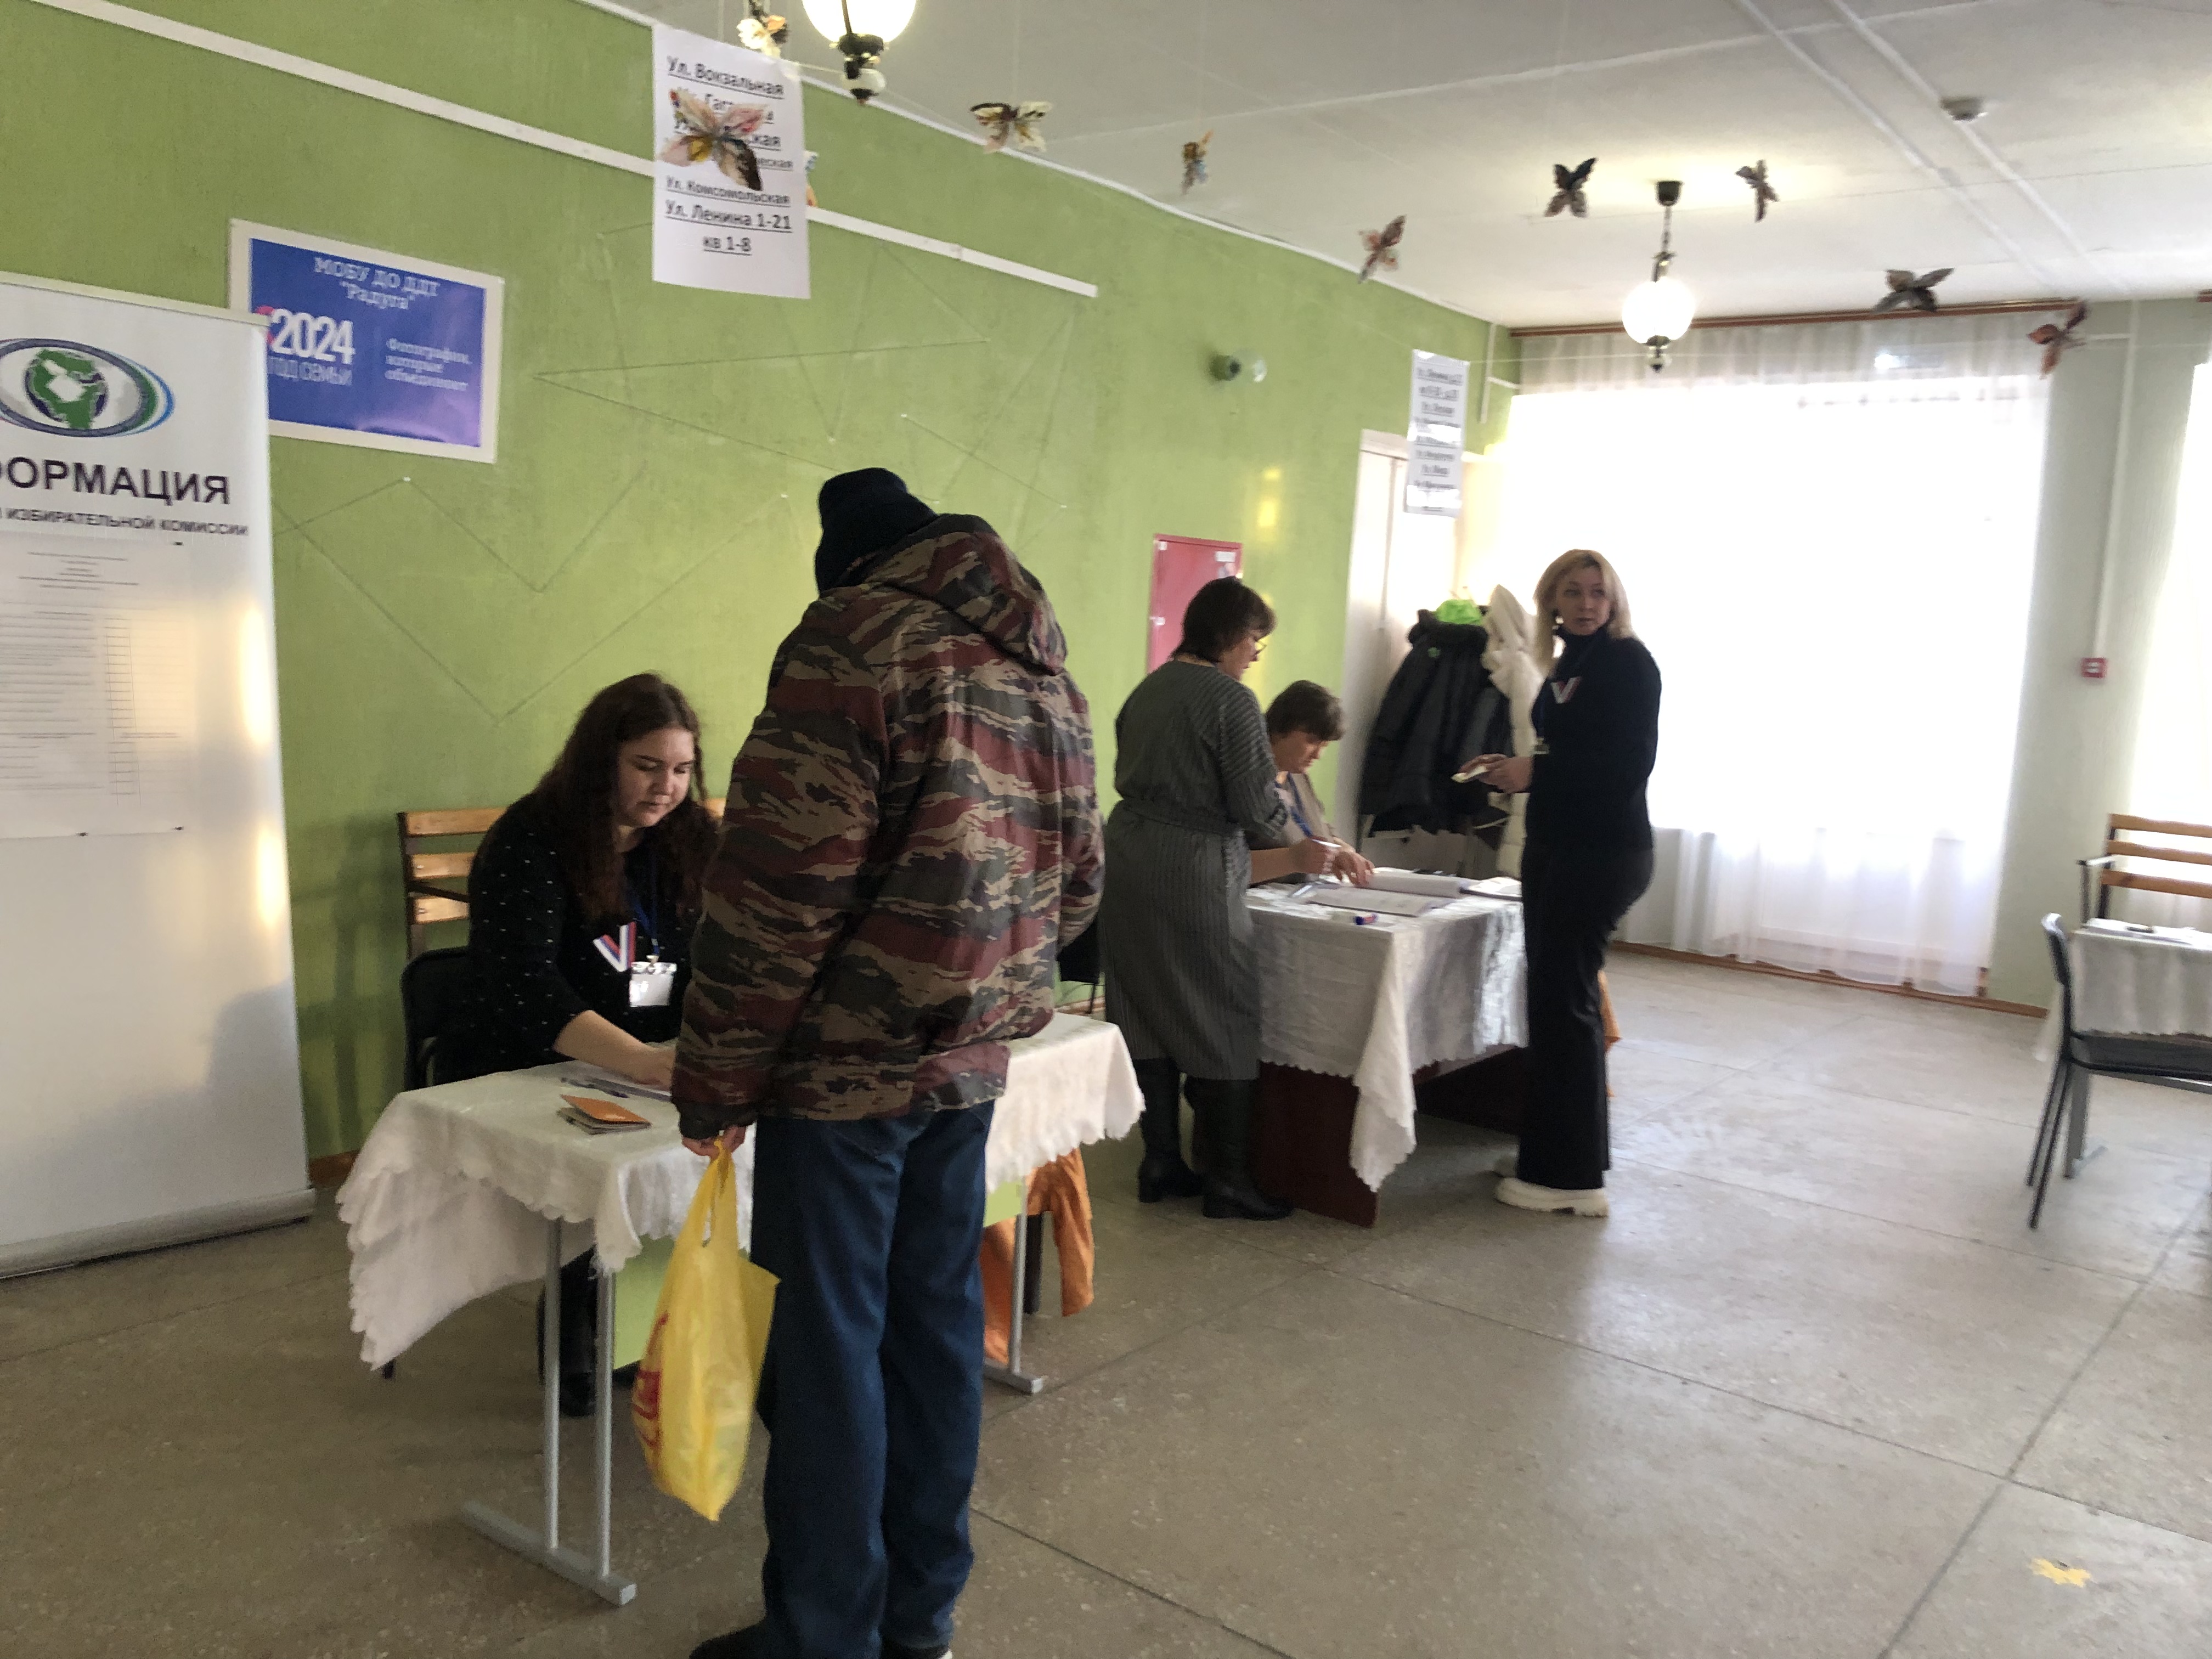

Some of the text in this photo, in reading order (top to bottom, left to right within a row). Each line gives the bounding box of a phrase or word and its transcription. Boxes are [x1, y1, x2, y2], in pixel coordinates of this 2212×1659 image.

[667, 55, 784, 95] Ул. Вокзальная
[687, 180, 791, 204] Комсомольская
[665, 200, 792, 229] Ул. Ленина 1-21
[703, 236, 752, 252] кв 1-8
[270, 308, 356, 365] 2024
[0, 456, 230, 506] ОРМАЦИЯ
[5, 507, 156, 530] ИЗБИРАТЕЛЬНОЙ
[160, 518, 249, 537] КОМИССИИ
